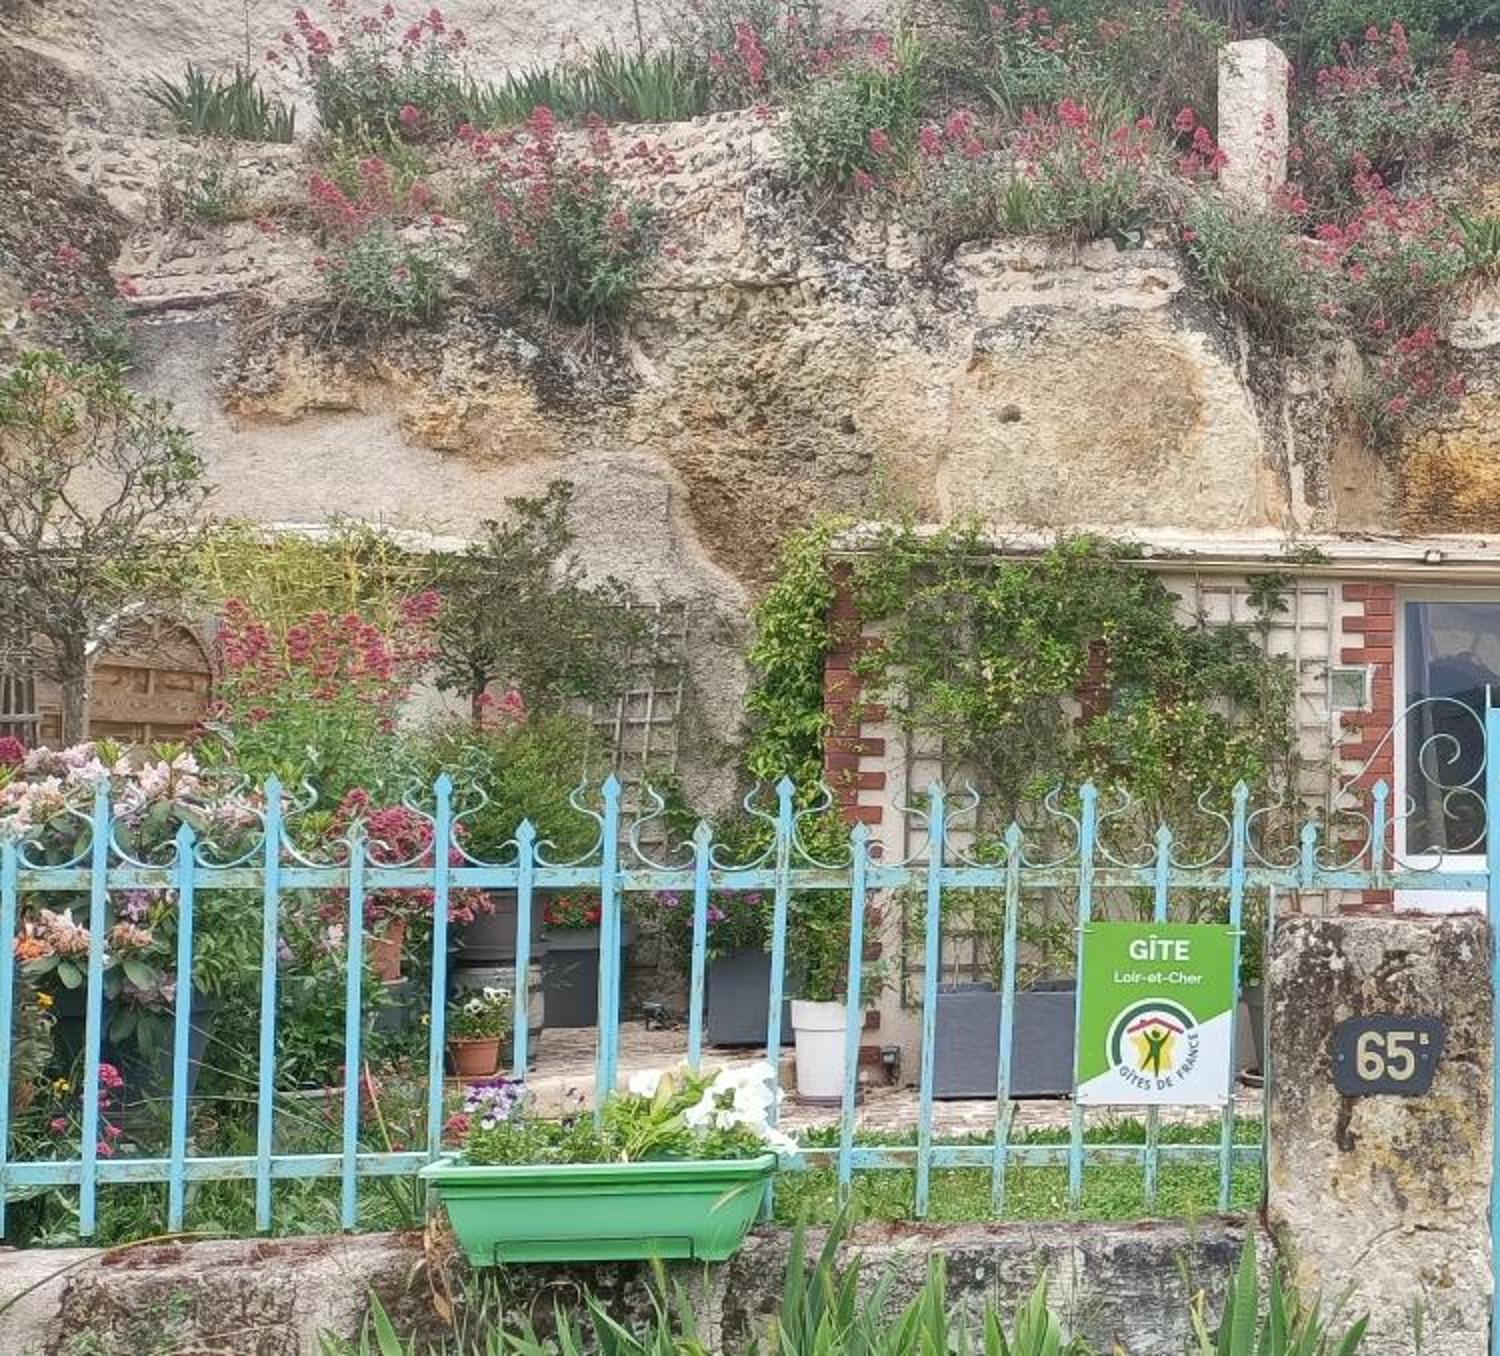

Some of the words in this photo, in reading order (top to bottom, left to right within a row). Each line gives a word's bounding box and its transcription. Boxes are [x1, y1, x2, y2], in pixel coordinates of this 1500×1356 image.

[1129, 934, 1190, 961] GÎTE
[1113, 971, 1204, 985] Loir-et-Cher
[1157, 1078, 1174, 1091] DE
[1177, 1032, 1199, 1080] FRANCE
